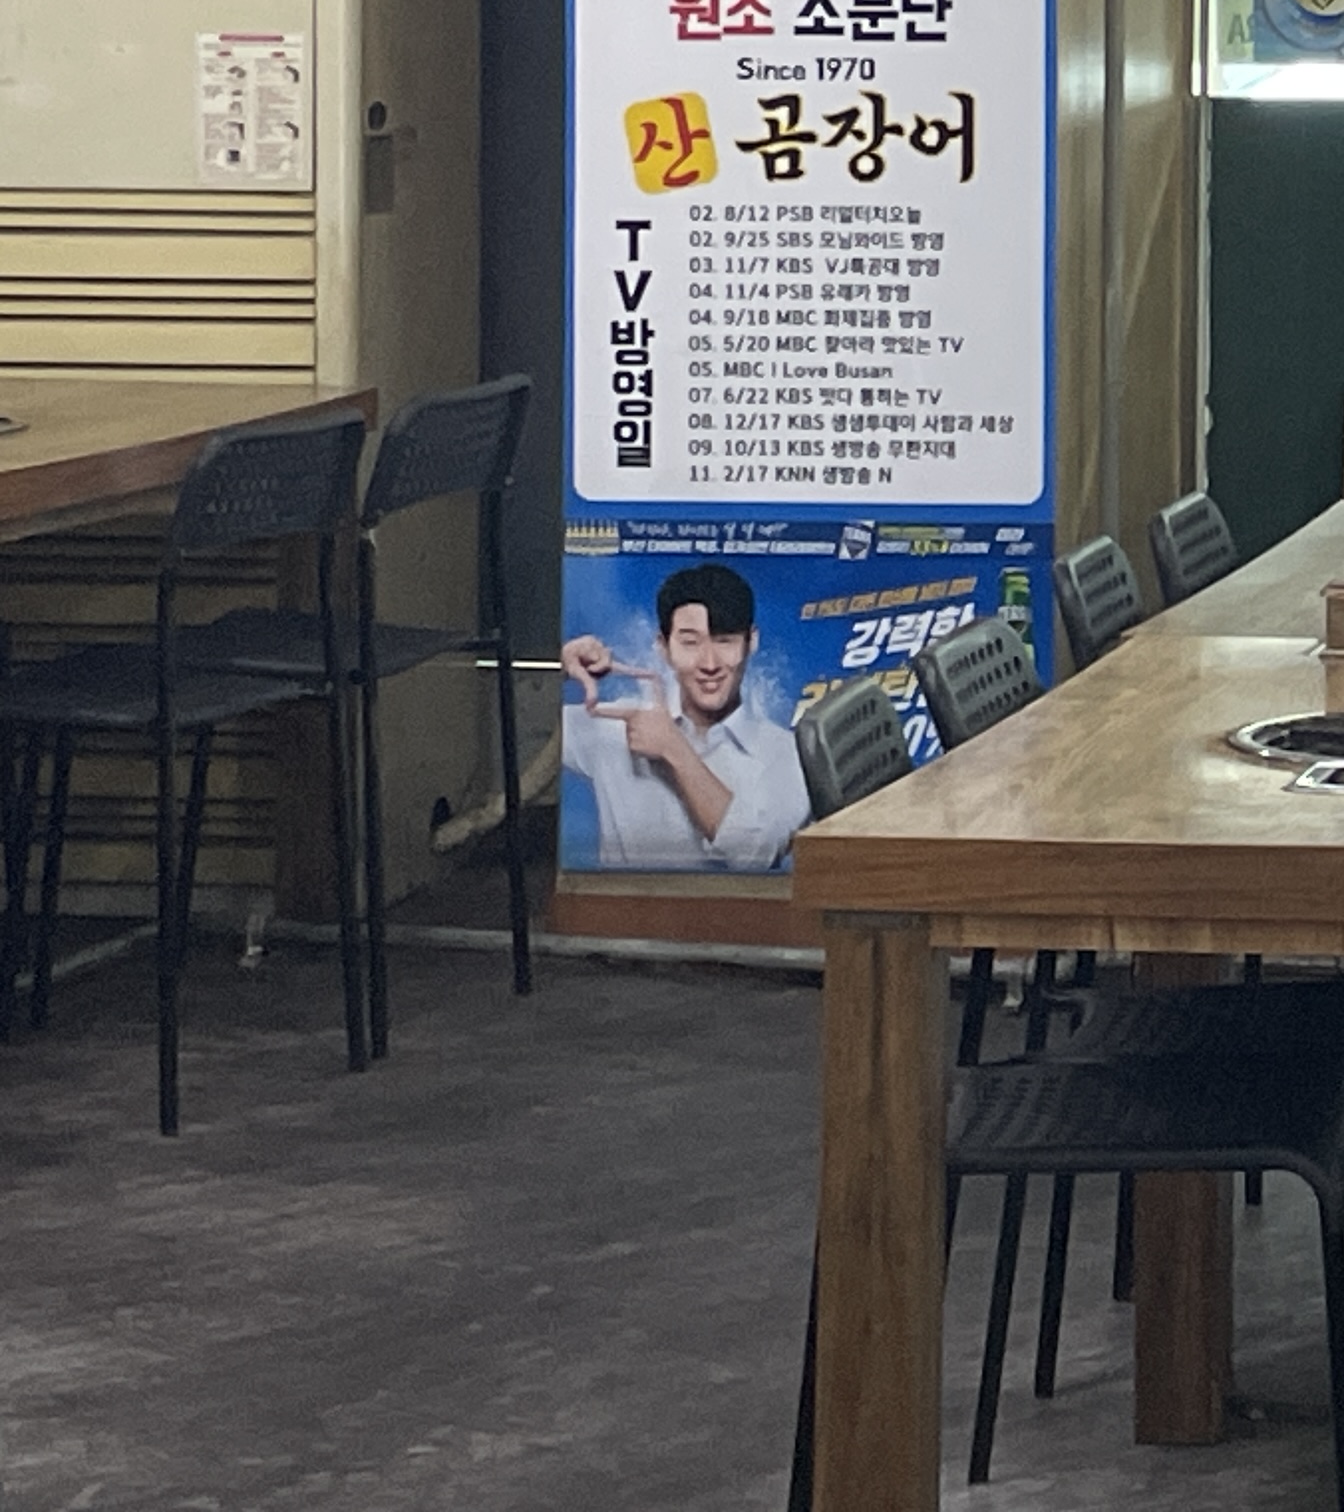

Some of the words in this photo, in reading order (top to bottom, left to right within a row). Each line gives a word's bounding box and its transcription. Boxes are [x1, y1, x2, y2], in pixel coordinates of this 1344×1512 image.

[736, 57, 807, 82] Since
[815, 57, 876, 82] 1970
[632, 96, 711, 188] 산
[735, 90, 977, 184] 곰장어
[723, 204, 771, 223] 8/12
[775, 204, 815, 223] PSB
[723, 230, 771, 249] 9/25
[776, 231, 814, 249] SBS
[724, 256, 771, 275] 11/7
[775, 257, 814, 275] KBS
[824, 257, 901, 278] VJ특공대
[725, 282, 771, 301] 11/4
[775, 283, 814, 301] PSB
[722, 307, 771, 327] 9/18
[774, 308, 819, 327] MBC
[610, 219, 656, 469] TV방영일
[722, 334, 771, 353] 5/20
[774, 335, 819, 353] MBC
[937, 335, 966, 354] TV
[722, 360, 766, 379] MBC
[770, 361, 778, 379] I
[782, 361, 829, 379] Love
[834, 361, 894, 379] Busan
[722, 386, 770, 405] 6/22
[774, 387, 814, 405] KBS
[915, 387, 944, 406] TV
[724, 412, 782, 431] 12/17
[786, 413, 826, 431] KBS
[724, 439, 781, 457] 10/13
[786, 439, 826, 457] KBS
[722, 464, 769, 484] 2/17
[774, 465, 816, 483] KNN
[877, 466, 893, 485] N
